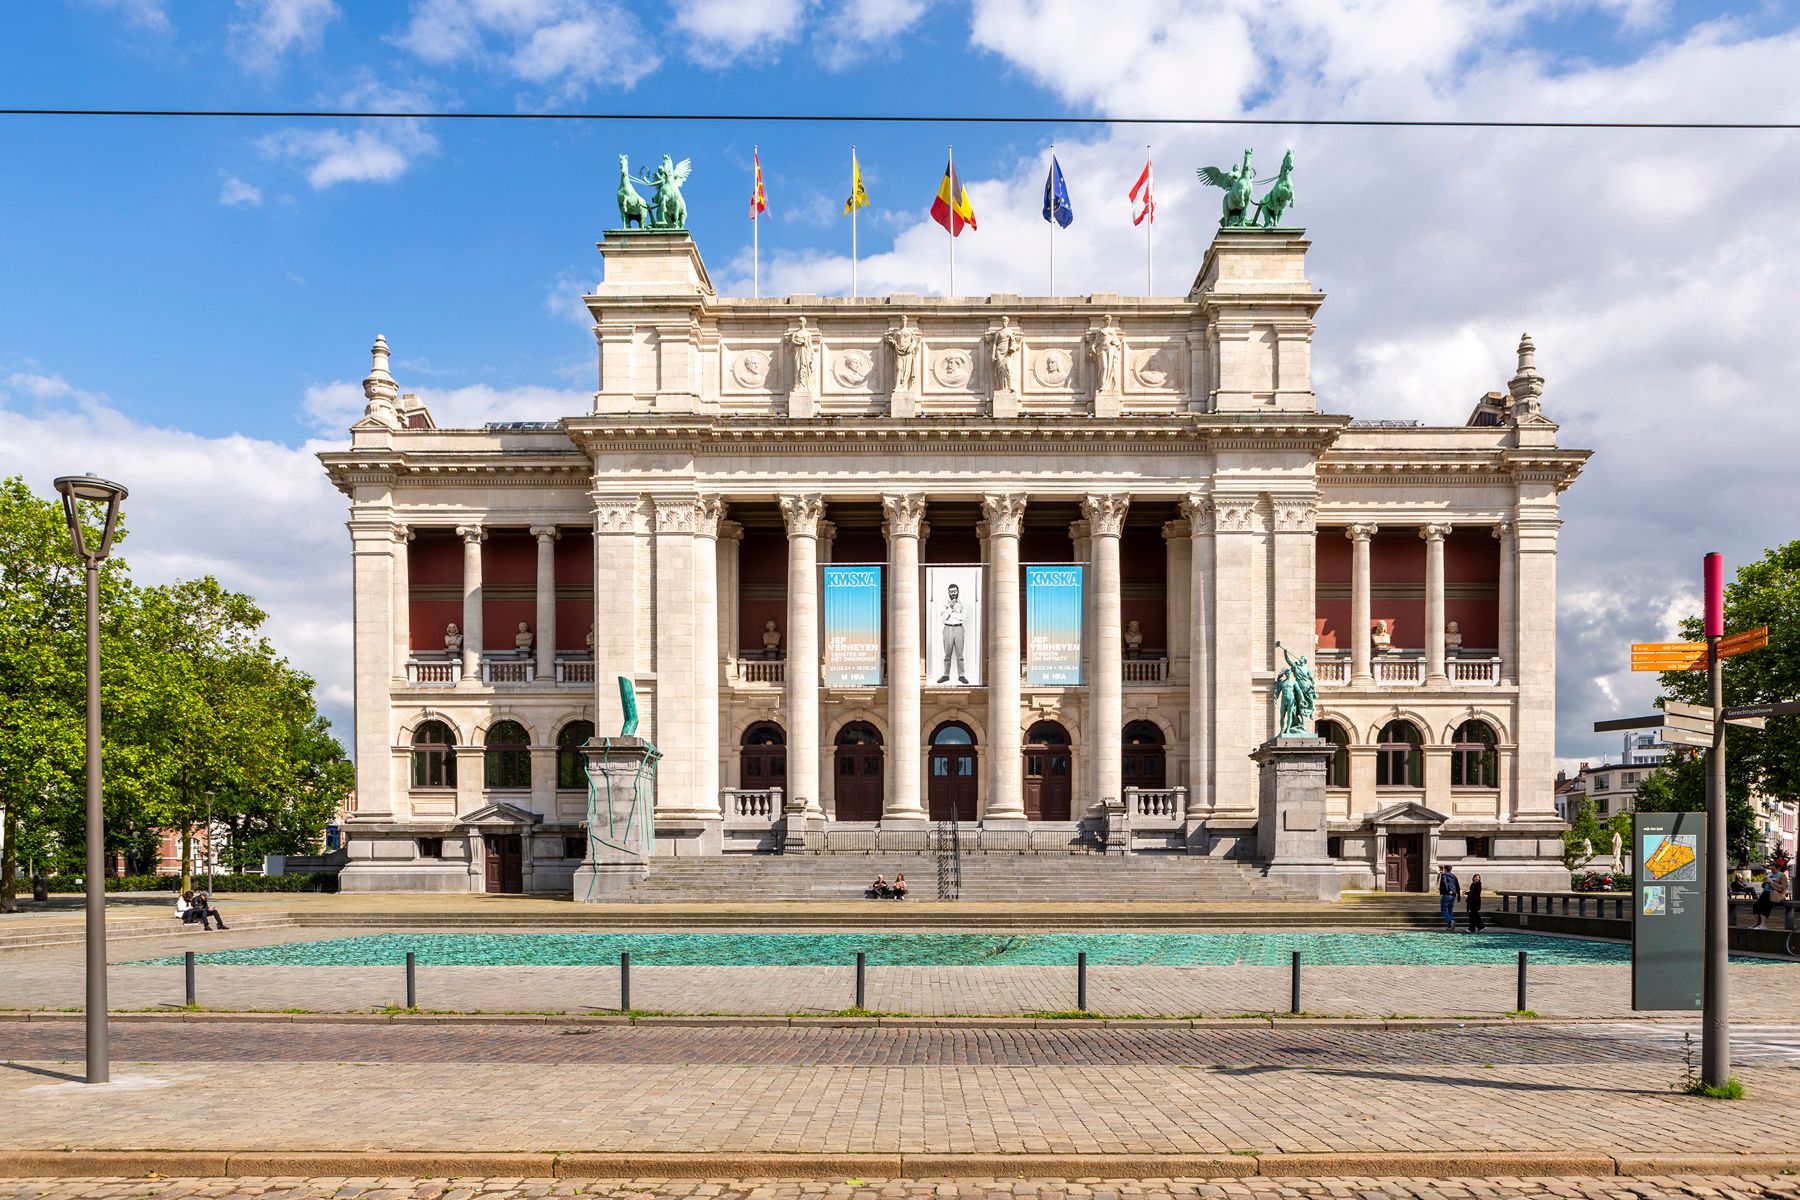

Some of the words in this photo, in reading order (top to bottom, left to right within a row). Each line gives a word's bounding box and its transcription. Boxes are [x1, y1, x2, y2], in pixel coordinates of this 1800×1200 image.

[828, 572, 876, 587] KMSKA
[1030, 572, 1079, 586] KMSKA
[1728, 708, 1773, 716] Gerechtsgebouw
